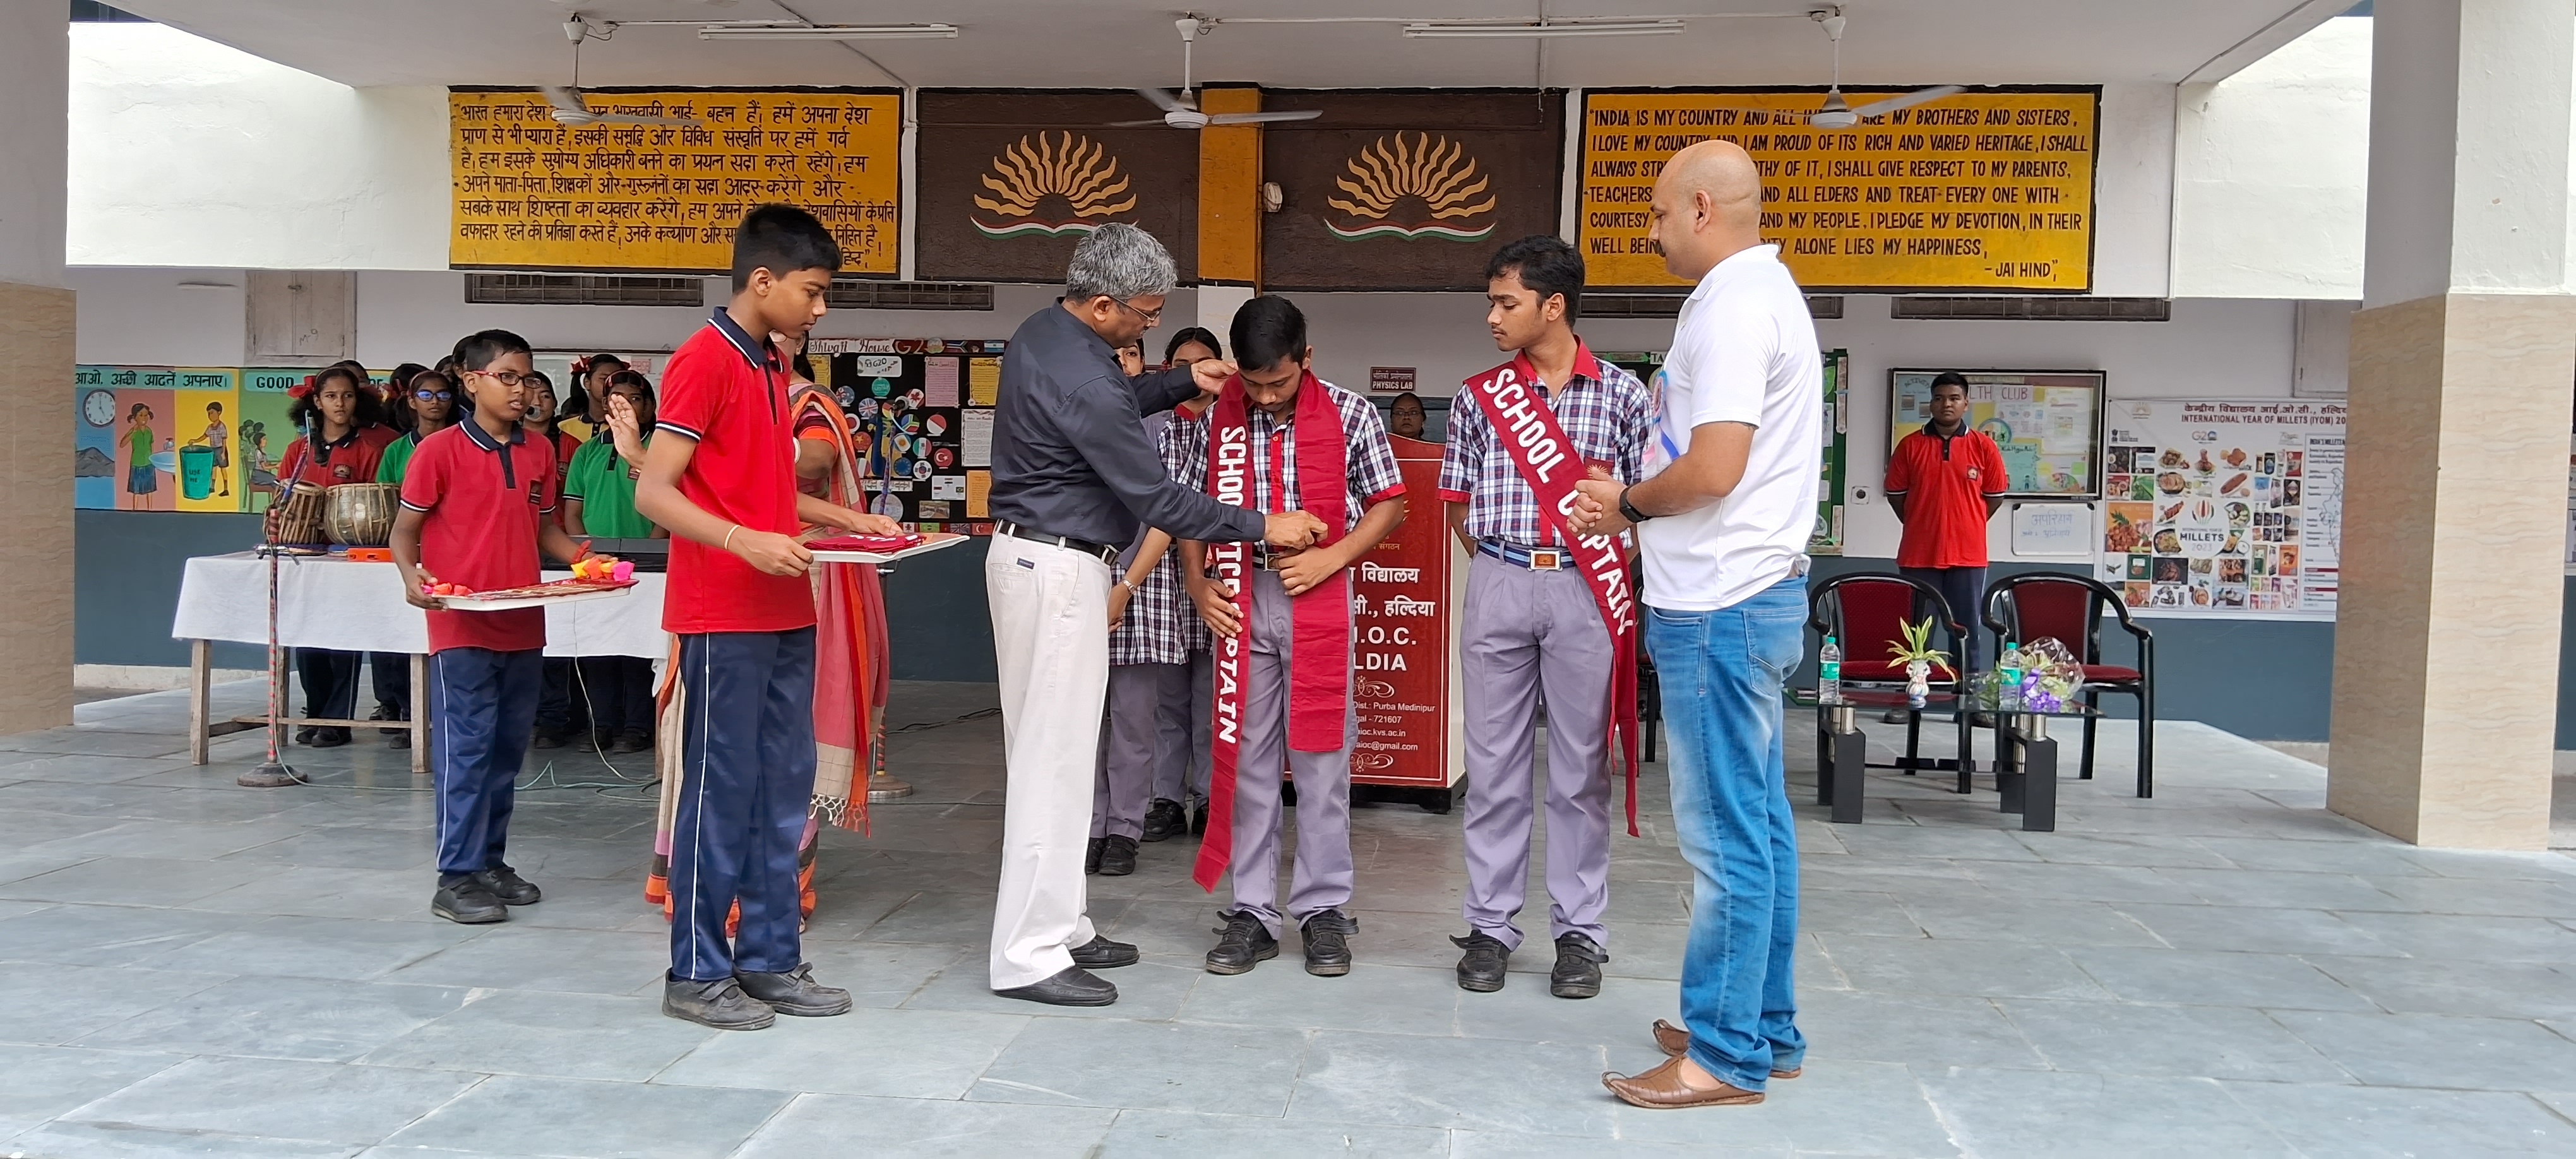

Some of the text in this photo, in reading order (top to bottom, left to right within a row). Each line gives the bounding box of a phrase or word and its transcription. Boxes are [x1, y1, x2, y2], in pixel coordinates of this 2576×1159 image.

[493, 105, 526, 121] हमारा
[526, 100, 548, 122] देश
[707, 106, 737, 123] बहन
[773, 100, 797, 124] हमें
[801, 106, 840, 124] अपना
[844, 101, 873, 125] देश
[1636, 109, 1649, 126] IS
[1654, 109, 1676, 126] MY
[1678, 109, 1739, 126] COUNTRY
[1743, 110, 1768, 126] AND
[1772, 109, 1796, 126] ALL
[1892, 109, 1911, 125] MY
[1916, 109, 1979, 126] BROTHERS
[1984, 109, 2010, 126] AND
[460, 128, 487, 145] प्राण
[492, 123, 505, 145] से
[507, 122, 523, 145] भी
[523, 129, 554, 145] प्यारा
[574, 123, 610, 147] इसकी
[650, 124, 677, 146] और
[680, 124, 715, 147] विविध
[768, 131, 790, 148] पर
[794, 127, 819, 149] हमें
[826, 125, 851, 149] गर्व
[1592, 134, 1597, 152] I
[1598, 134, 1628, 152] LOVE
[1633, 134, 1651, 152] MY
[1749, 134, 1768, 152] AM
[1774, 134, 1812, 151] PROUD
[1818, 134, 1835, 151] OF
[1838, 134, 1857, 151] ITS
[1864, 134, 1893, 151] RICH
[1897, 134, 1924, 151] AND
[1929, 134, 1970, 151] VARIED
[2041, 135, 2046, 152] I
[2046, 134, 2089, 152] SHALL
[479, 152, 501, 169] हम
[503, 146, 536, 170] इसके
[583, 146, 636, 170] अधिकारी
[638, 148, 665, 170] बनने
[669, 154, 688, 171] का
[730, 154, 759, 172] सदा
[764, 150, 799, 172] करते
[843, 156, 869, 174] हम
[1590, 160, 1637, 177] ALWAYS
[1785, 160, 1801, 177] OF
[1827, 160, 1832, 177] I
[1834, 160, 1874, 177] SHALL
[1878, 160, 1904, 177] GIVE
[1909, 160, 1965, 177] RESPECT
[1971, 160, 1986, 177] TO
[1991, 160, 2008, 177] MY
[462, 170, 492, 193] अपने
[672, 178, 691, 195] का
[694, 179, 720, 196] सदा
[766, 173, 806, 197] करेंगे
[813, 172, 847, 198] और
[1589, 186, 1653, 205] TEACHERS
[1786, 186, 1810, 203] ALL
[1814, 186, 1859, 203] ELDERS
[1865, 186, 1892, 203] AND
[1898, 186, 1939, 203] TREAT
[1946, 186, 1986, 203] EVERY
[1992, 187, 2018, 203] ONE
[2025, 187, 2059, 203] WITH
[459, 195, 494, 216] सबके
[495, 200, 523, 217] साथ
[575, 201, 595, 218] का
[597, 201, 643, 219] व्यवहार
[688, 203, 709, 220] हम
[712, 198, 744, 220] अपने
[1758, 211, 1783, 229] AND
[1789, 212, 1807, 229] MY
[1870, 212, 1874, 229] I
[1877, 212, 1924, 229] PLEDGE
[1931, 212, 1950, 229] MY
[2029, 213, 2042, 229] IN
[2048, 213, 2082, 230] THEIR
[460, 223, 499, 240] वफादार
[503, 220, 527, 241] रहने
[544, 218, 577, 241] प्रतिज्ञा
[579, 219, 606, 242] करते
[624, 221, 652, 243] उनके
[701, 220, 722, 244] और
[835, 223, 864, 247] निहित
[1590, 237, 1625, 254] WELL
[1794, 237, 1836, 255] ALONE
[1844, 238, 1875, 255] LIES
[1883, 238, 1902, 255] MY
[1996, 262, 2014, 277] JAI
[859, 339, 890, 352] House
[145, 371, 176, 386] आदतें
[256, 377, 294, 389] GOOD
[1969, 386, 2028, 400] LTH CLUB
[2185, 403, 2215, 412] केन्द्रीय
[1482, 368, 1566, 484] SCHOOL
[2181, 415, 2239, 423] INTERNATIONAL
[2243, 415, 2262, 424] YEAR
[2310, 416, 2334, 425] (IYOM)
[2180, 533, 2224, 542] MILLETS
[1361, 561, 1420, 583] विद्यालय
[1384, 595, 1436, 617] हल्दिया
[1353, 653, 1407, 671] LDIA
[1374, 702, 1395, 710] Purba
[1398, 703, 1435, 713] Medinipur
[1374, 715, 1402, 723] 721607
